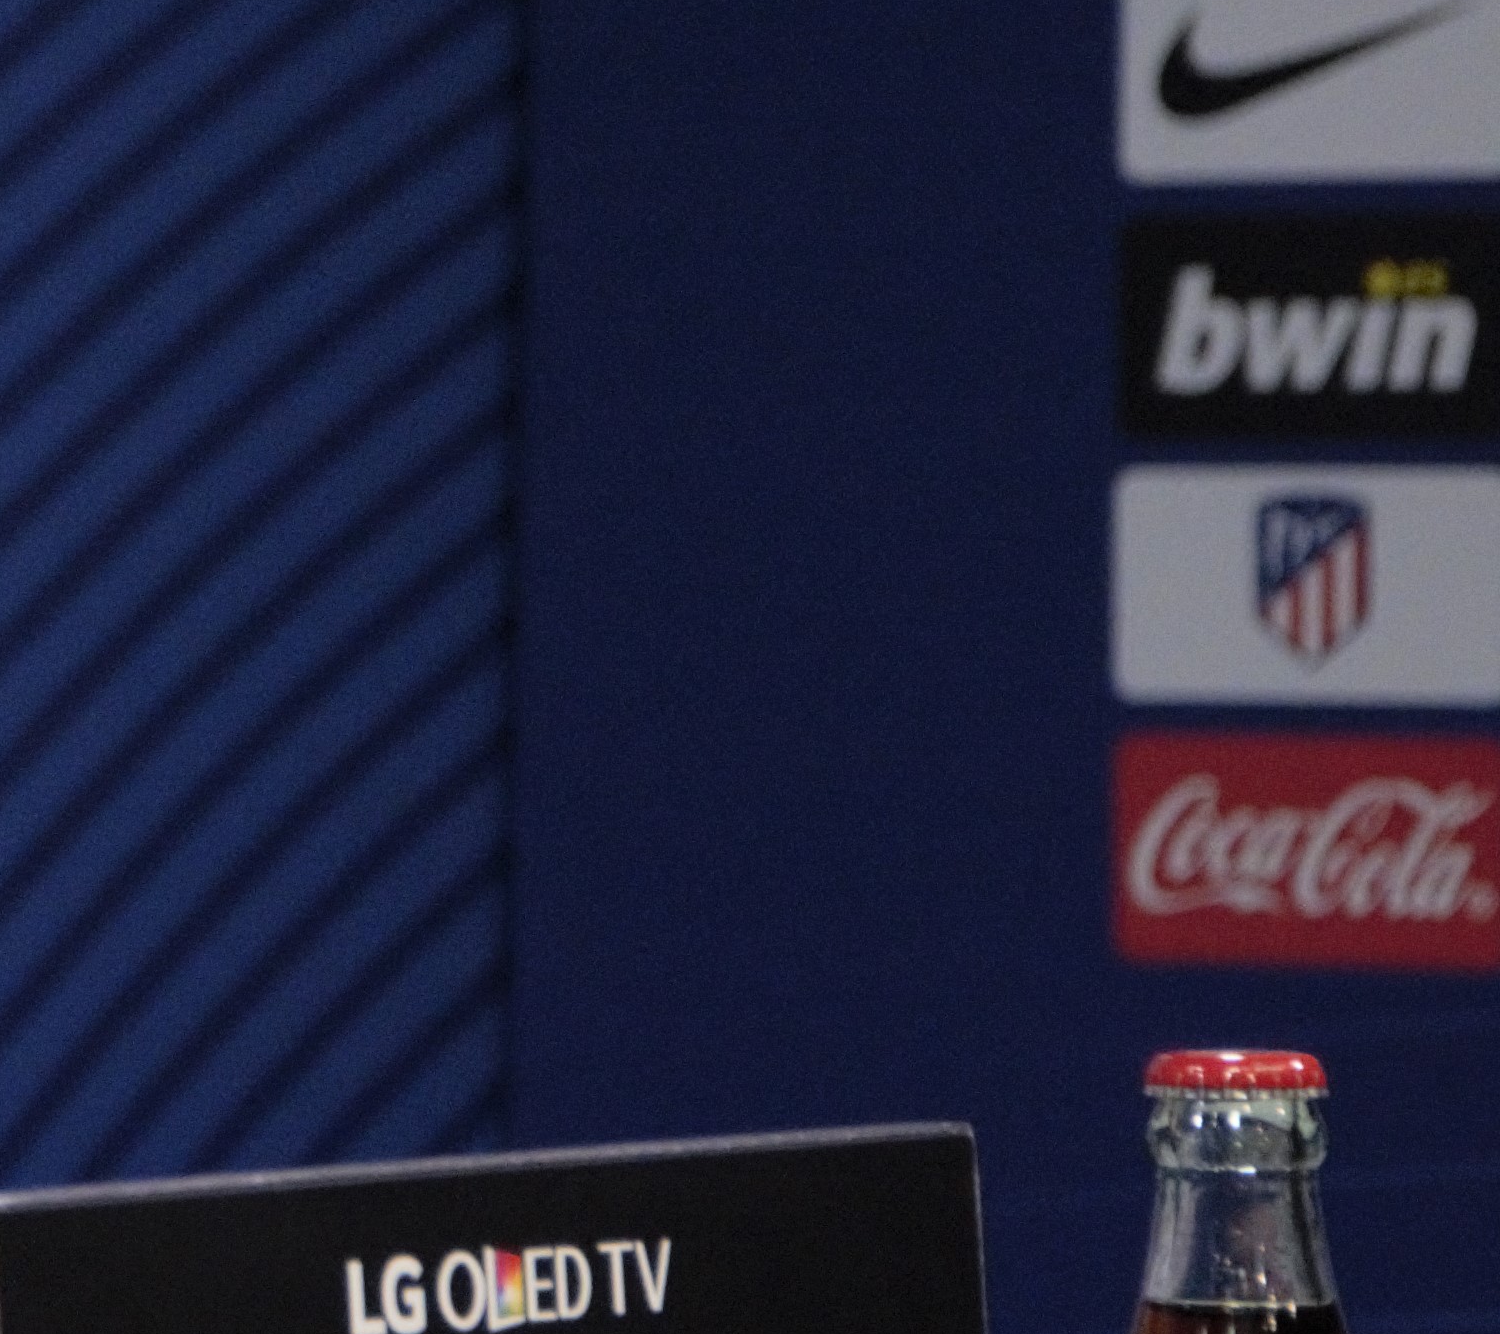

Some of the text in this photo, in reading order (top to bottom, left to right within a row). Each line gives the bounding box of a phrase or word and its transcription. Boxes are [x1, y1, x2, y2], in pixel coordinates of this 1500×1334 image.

[1158, 266, 1475, 393] bwin
[1127, 777, 1494, 918] Coca-Cola
[436, 1245, 592, 1332] OLED
[597, 1238, 672, 1316] TV
